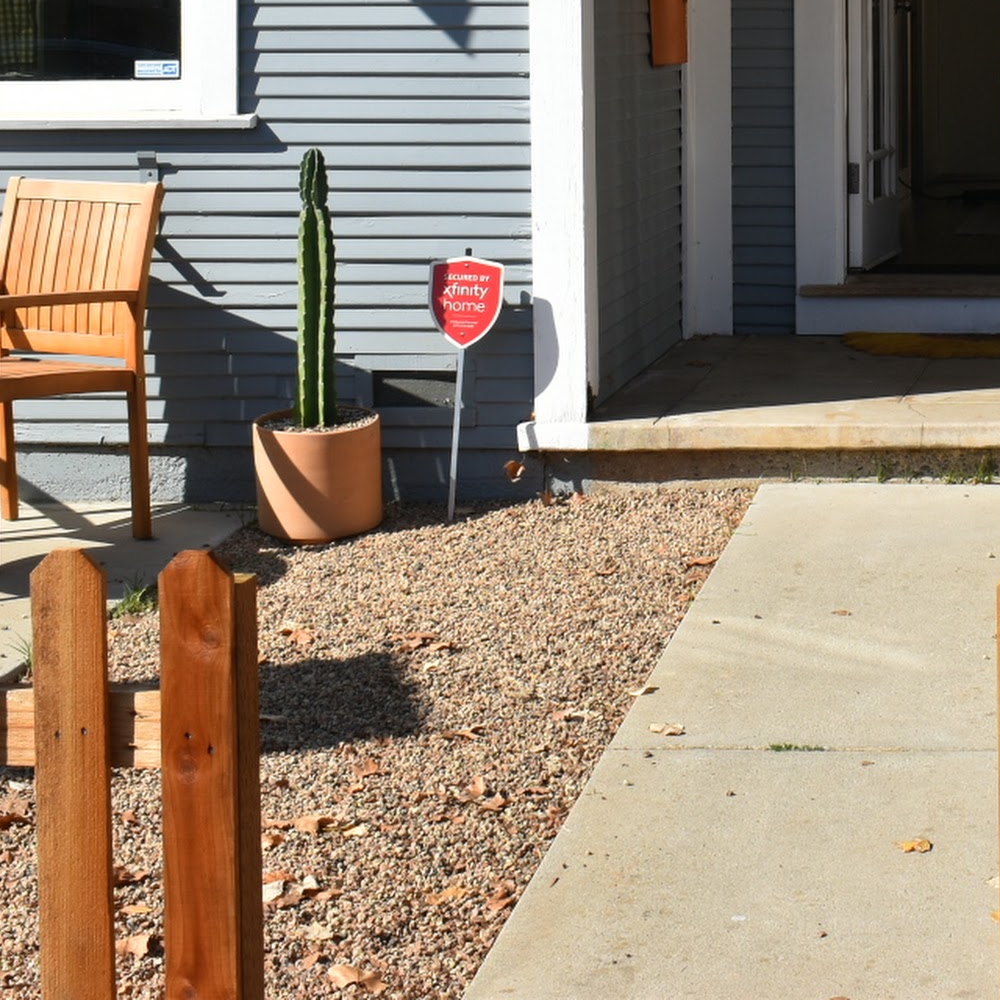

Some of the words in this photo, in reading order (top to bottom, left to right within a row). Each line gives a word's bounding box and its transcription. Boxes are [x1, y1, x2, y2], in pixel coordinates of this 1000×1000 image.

[444, 273, 478, 282] SECURED
[443, 282, 489, 300] xfinity
[443, 298, 486, 313] home
